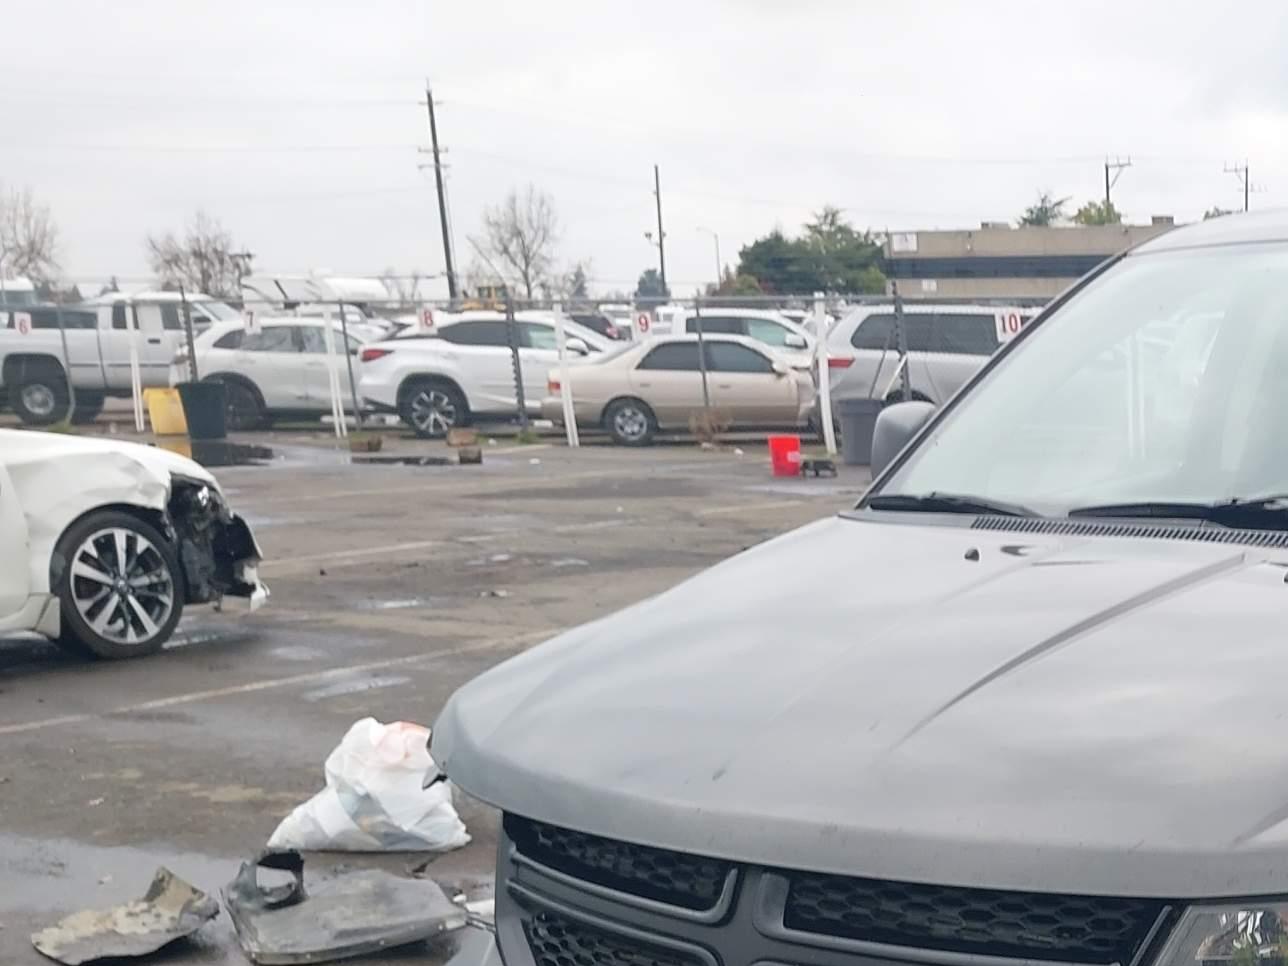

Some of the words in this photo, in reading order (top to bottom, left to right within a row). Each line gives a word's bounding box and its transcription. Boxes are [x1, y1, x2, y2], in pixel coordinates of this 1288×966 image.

[18, 317, 29, 335] 6
[422, 308, 434, 328] 8
[638, 312, 649, 332] 9
[1001, 313, 1018, 333] 10
